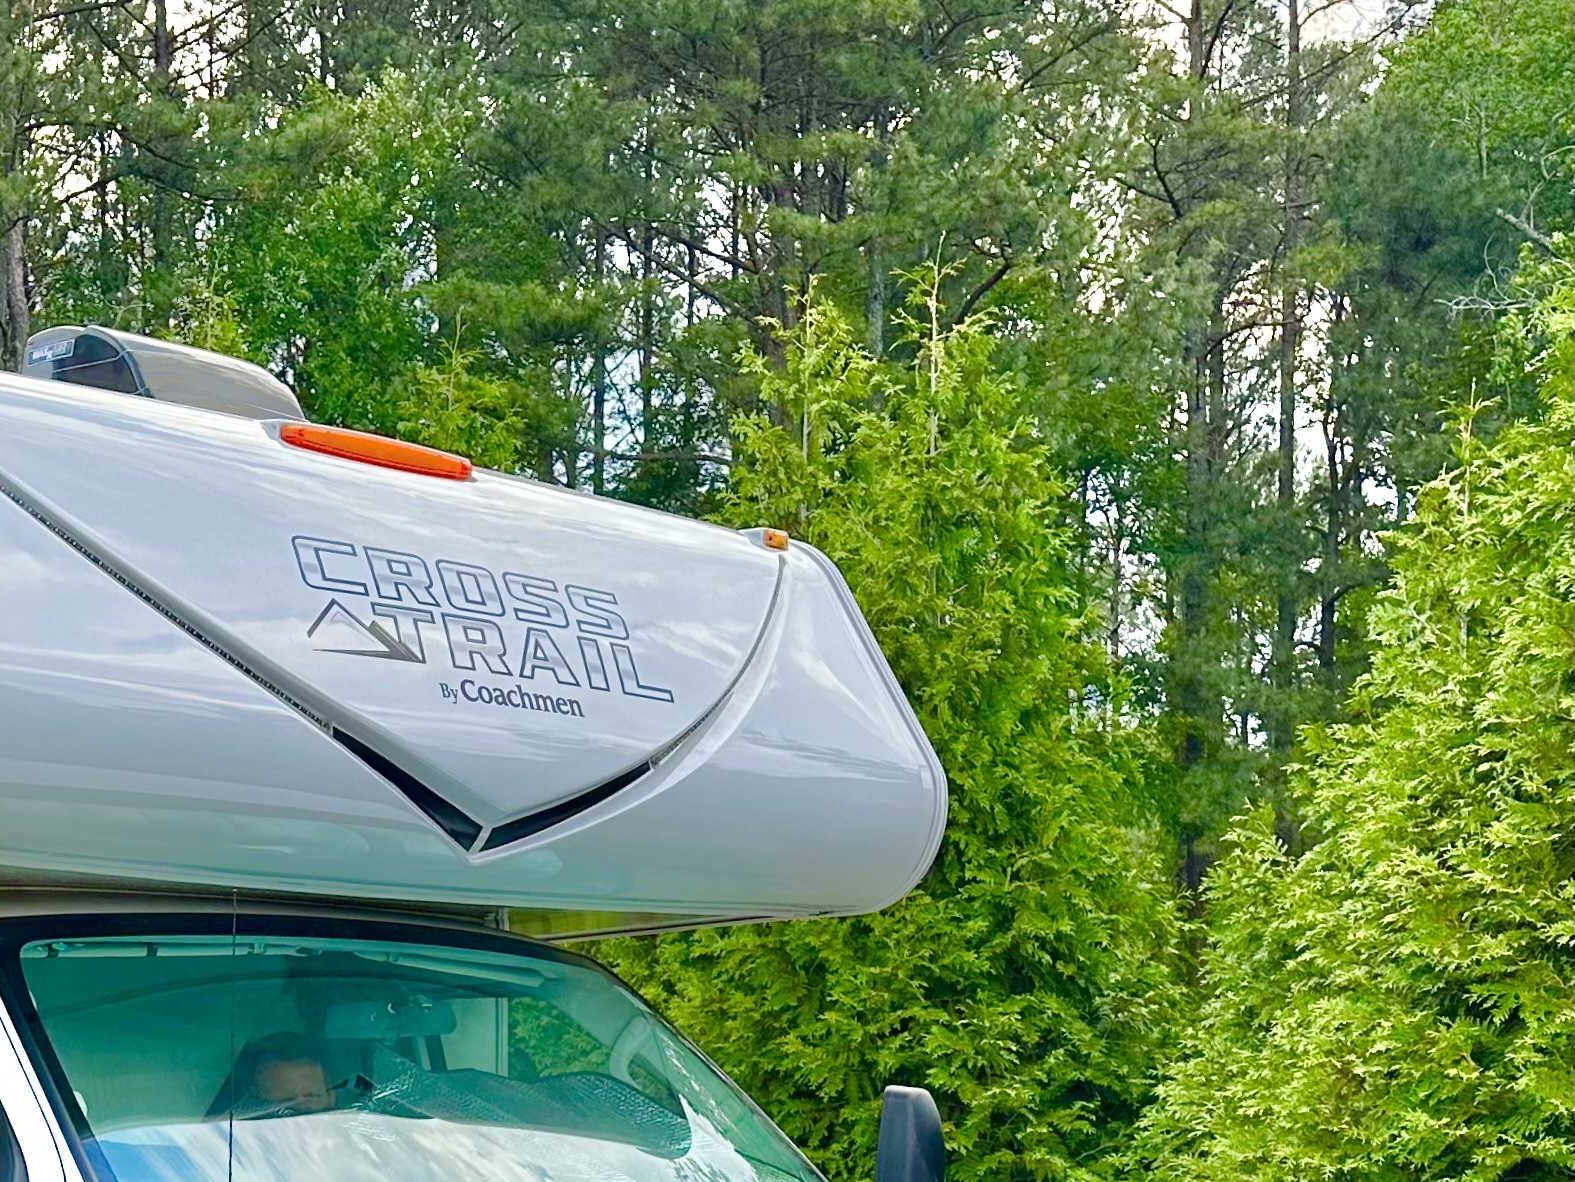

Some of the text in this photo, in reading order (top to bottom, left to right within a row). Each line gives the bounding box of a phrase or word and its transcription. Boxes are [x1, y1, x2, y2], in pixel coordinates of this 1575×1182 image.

[291, 535, 630, 641] CROSS
[370, 601, 675, 704] TRAIL
[439, 678, 585, 718] By Coachmen
